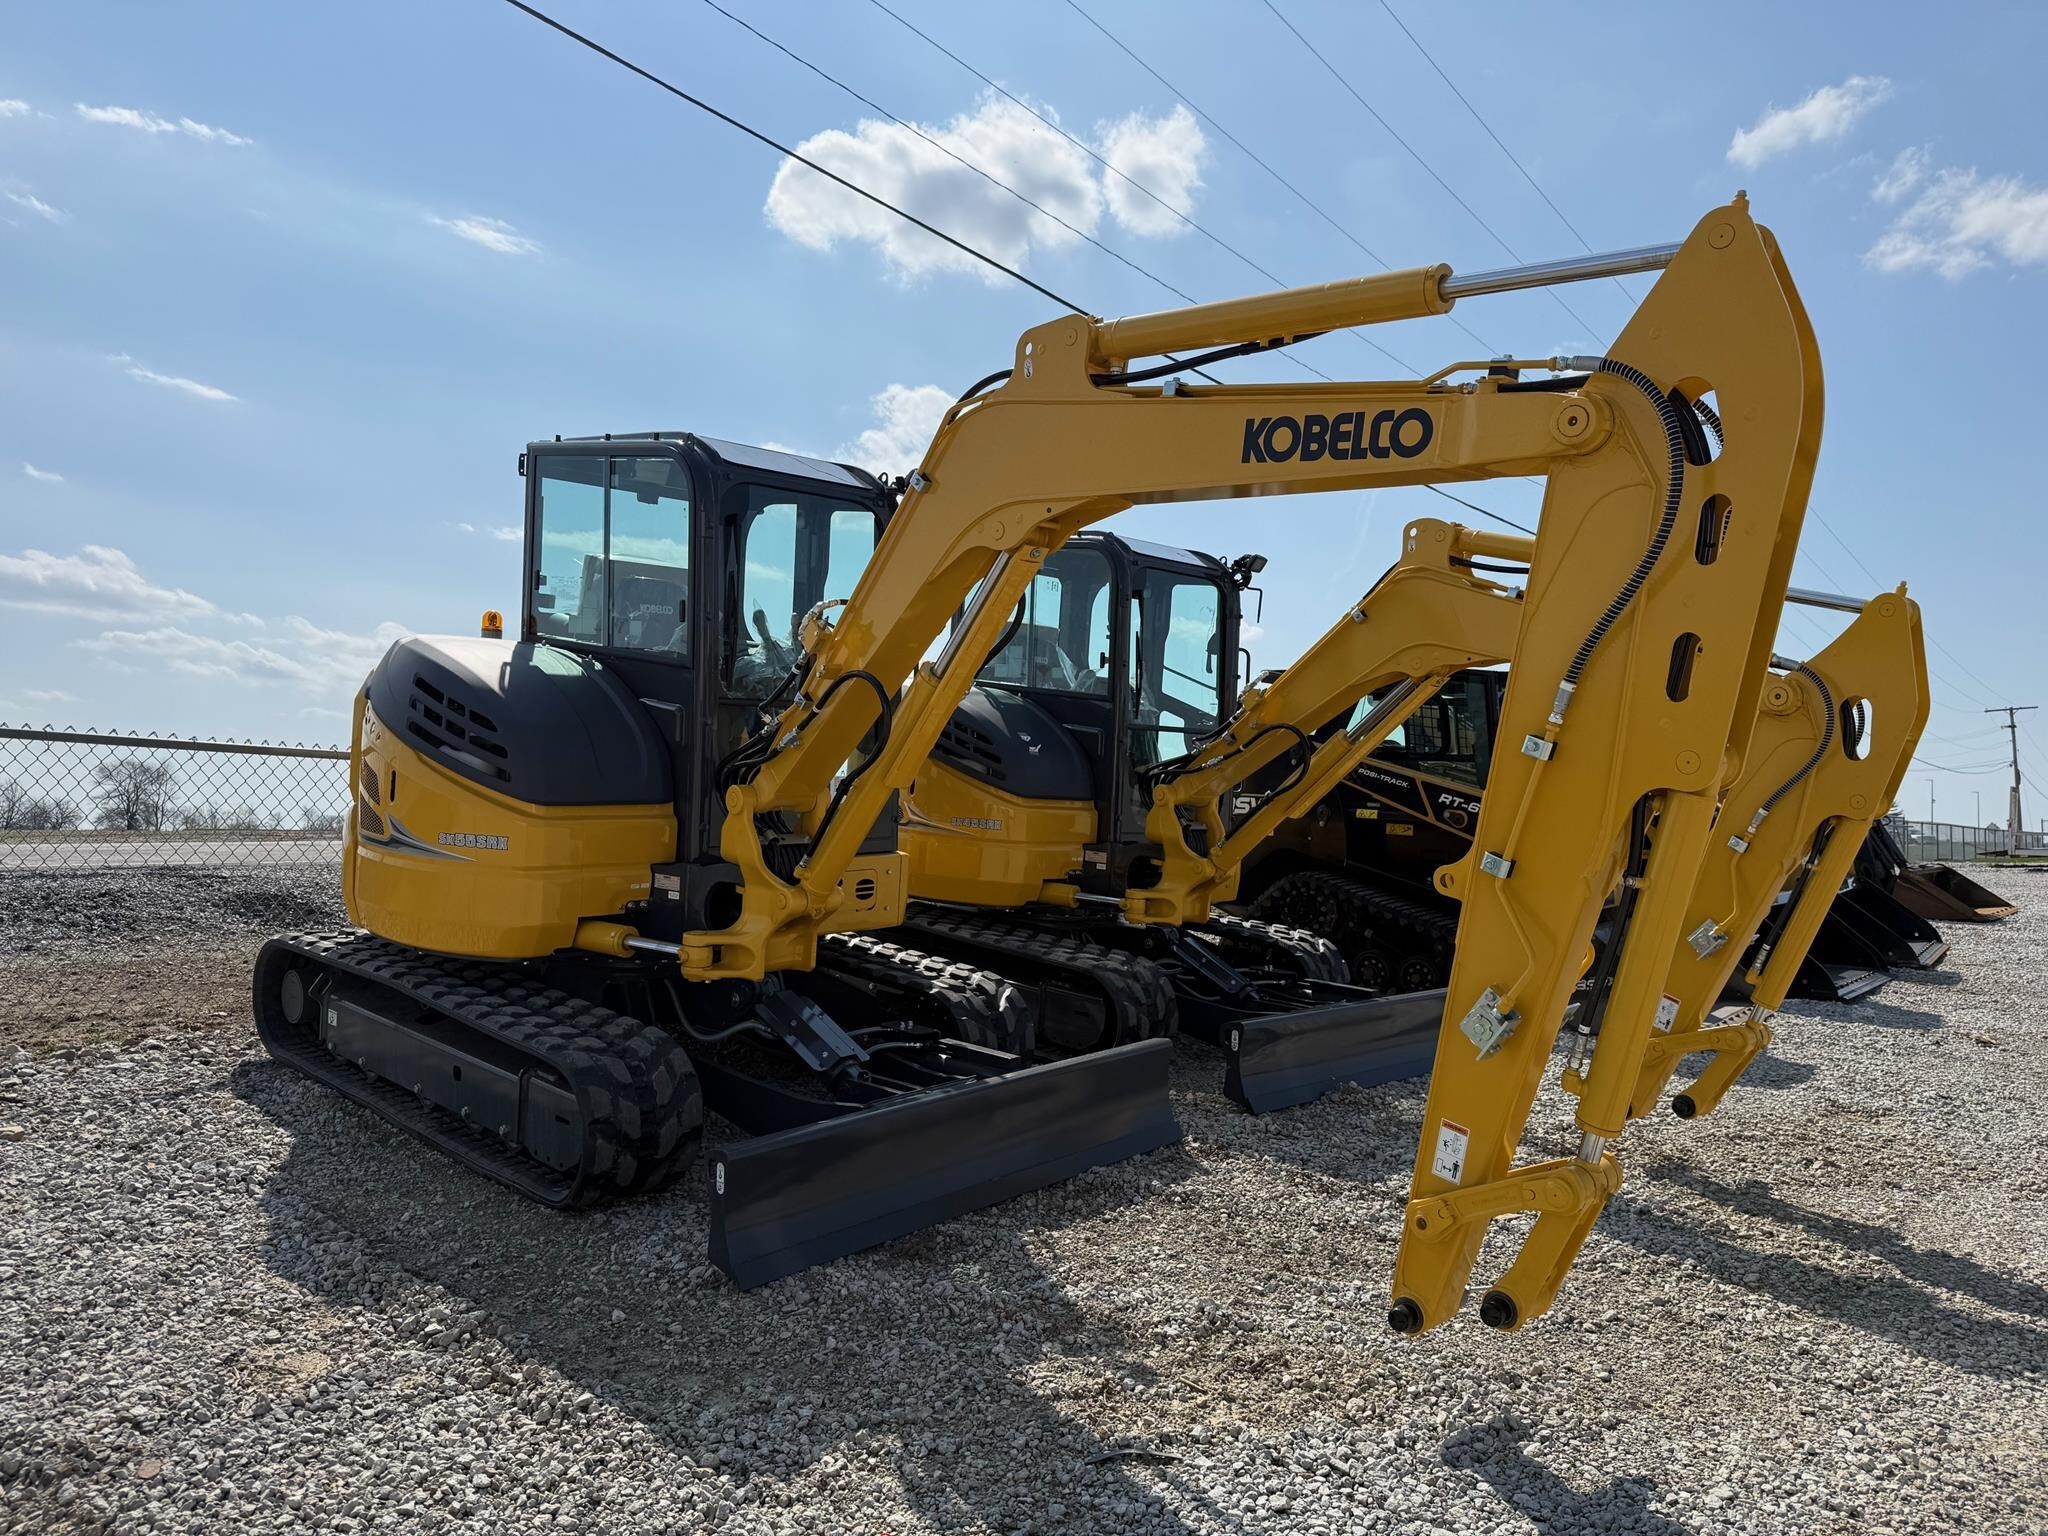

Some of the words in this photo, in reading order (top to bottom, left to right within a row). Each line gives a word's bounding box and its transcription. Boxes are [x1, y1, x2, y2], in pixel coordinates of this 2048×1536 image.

[1241, 408, 1434, 464] KOBELCO
[1358, 767, 1409, 788] POSI-TRACK
[438, 831, 510, 851] SK55SRX
